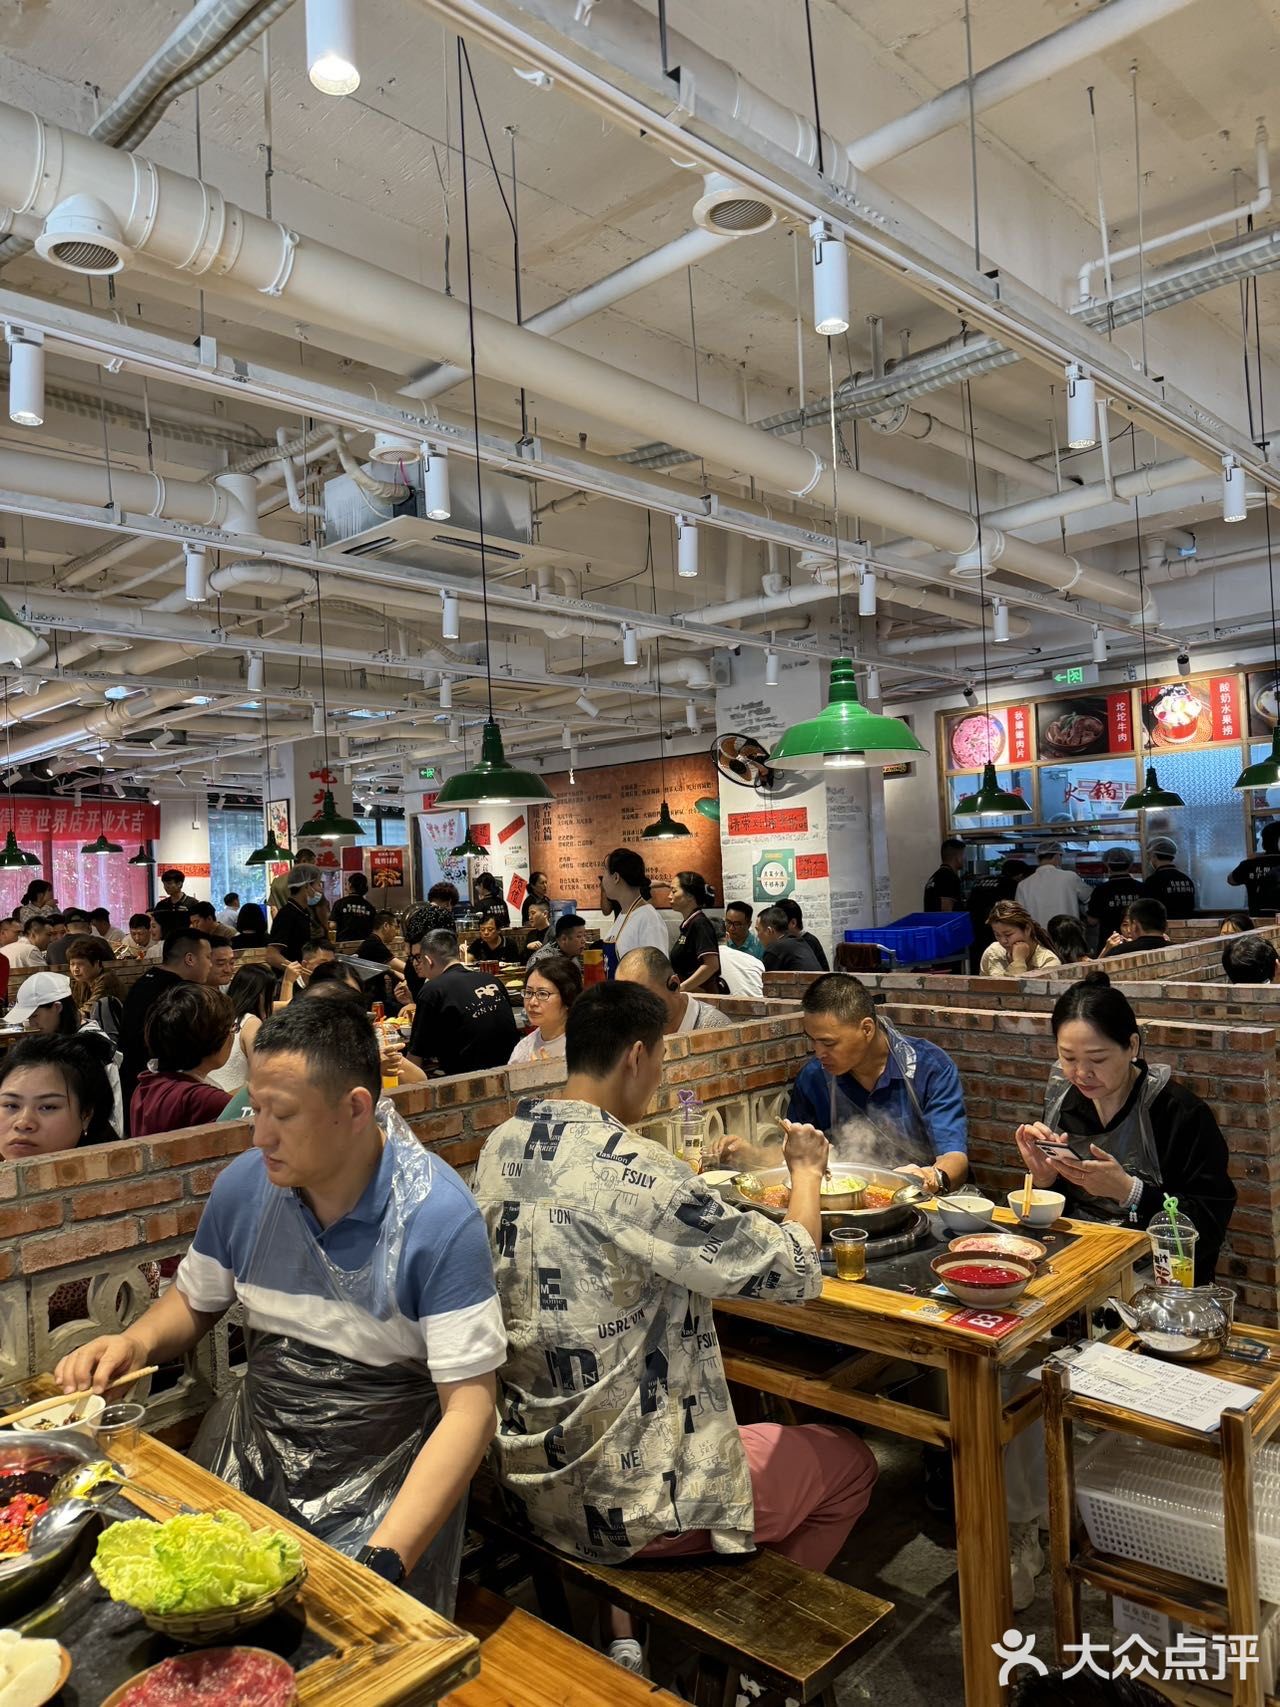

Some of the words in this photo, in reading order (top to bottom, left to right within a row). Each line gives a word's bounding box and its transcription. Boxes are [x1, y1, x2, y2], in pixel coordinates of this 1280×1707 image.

[1219, 682, 1233, 736] 酸奶水果捞
[1116, 702, 1128, 742] 坨坨牛肉
[501, 1162, 523, 1178] L'ON
[622, 1167, 658, 1190] FSJLY
[550, 1208, 571, 1225] L'ON
[700, 1236, 724, 1265] L'ON
[967, 1313, 1004, 1329] B3
